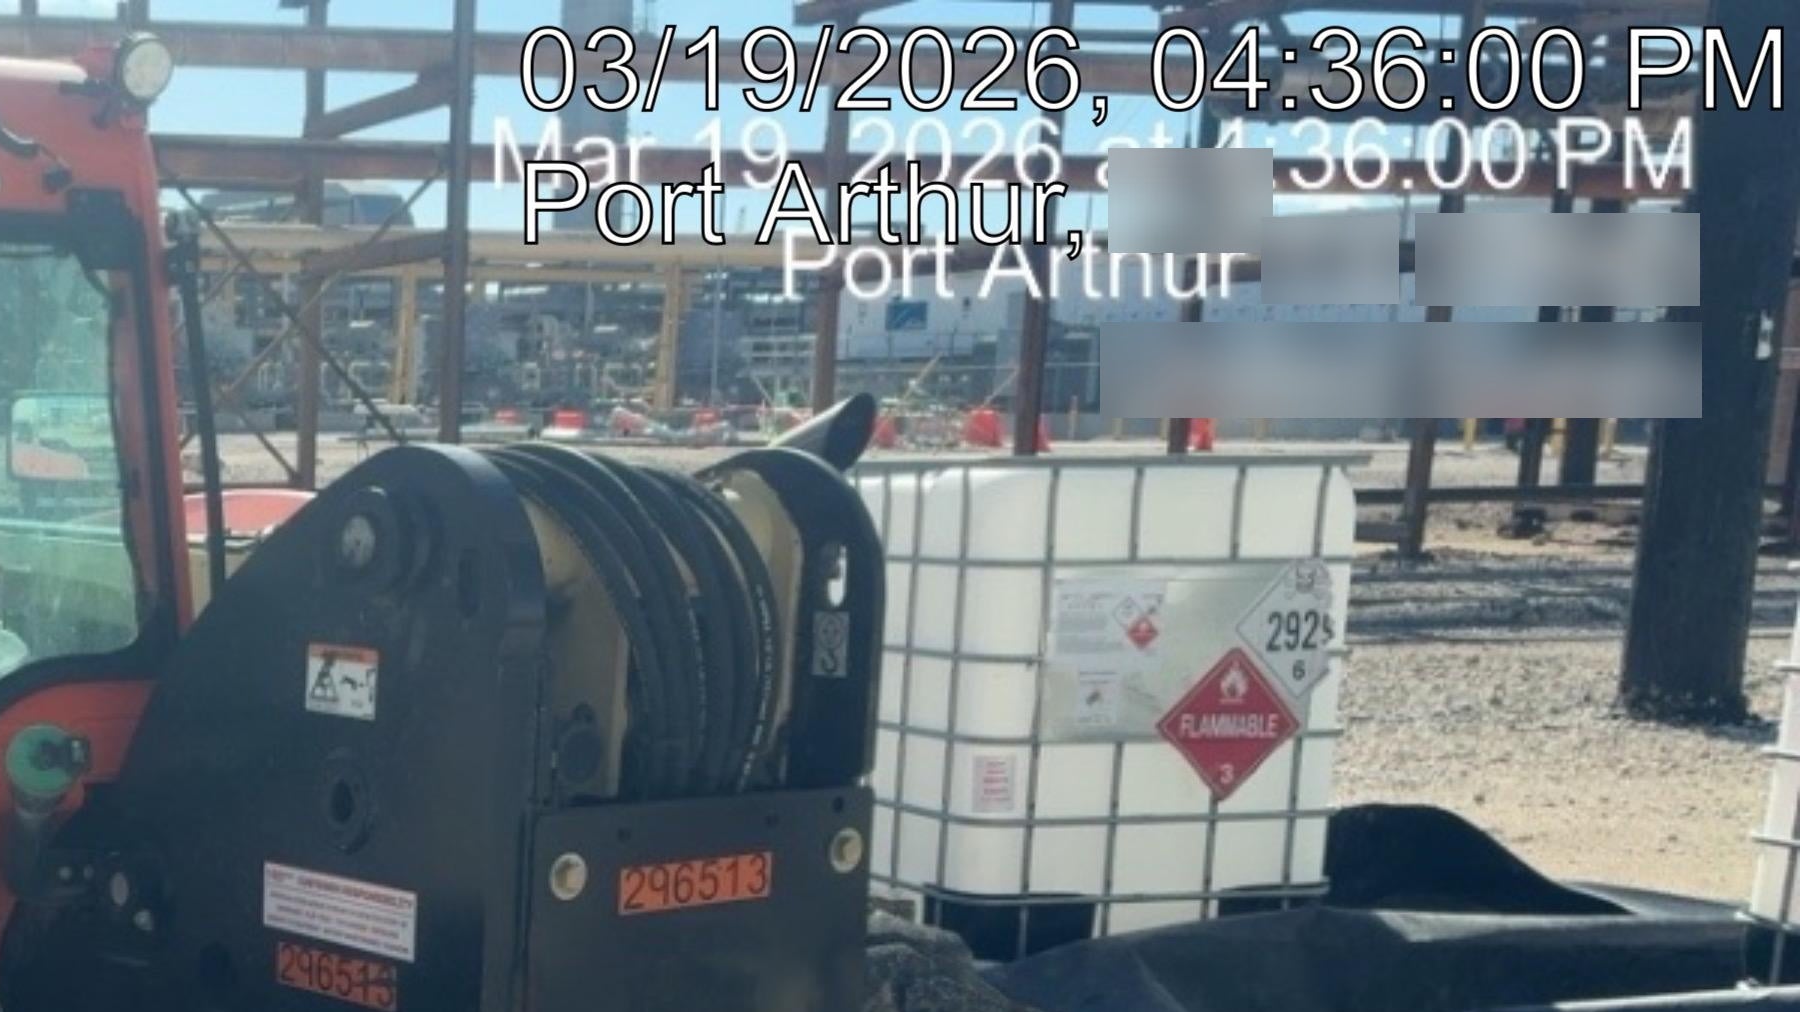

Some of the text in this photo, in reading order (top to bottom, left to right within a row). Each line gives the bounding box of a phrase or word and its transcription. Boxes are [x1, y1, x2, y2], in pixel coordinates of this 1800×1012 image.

[1292, 659, 1306, 681] 6
[1180, 712, 1280, 739] FLAMMABLE
[1219, 763, 1234, 785] 3
[623, 853, 767, 910] 296513
